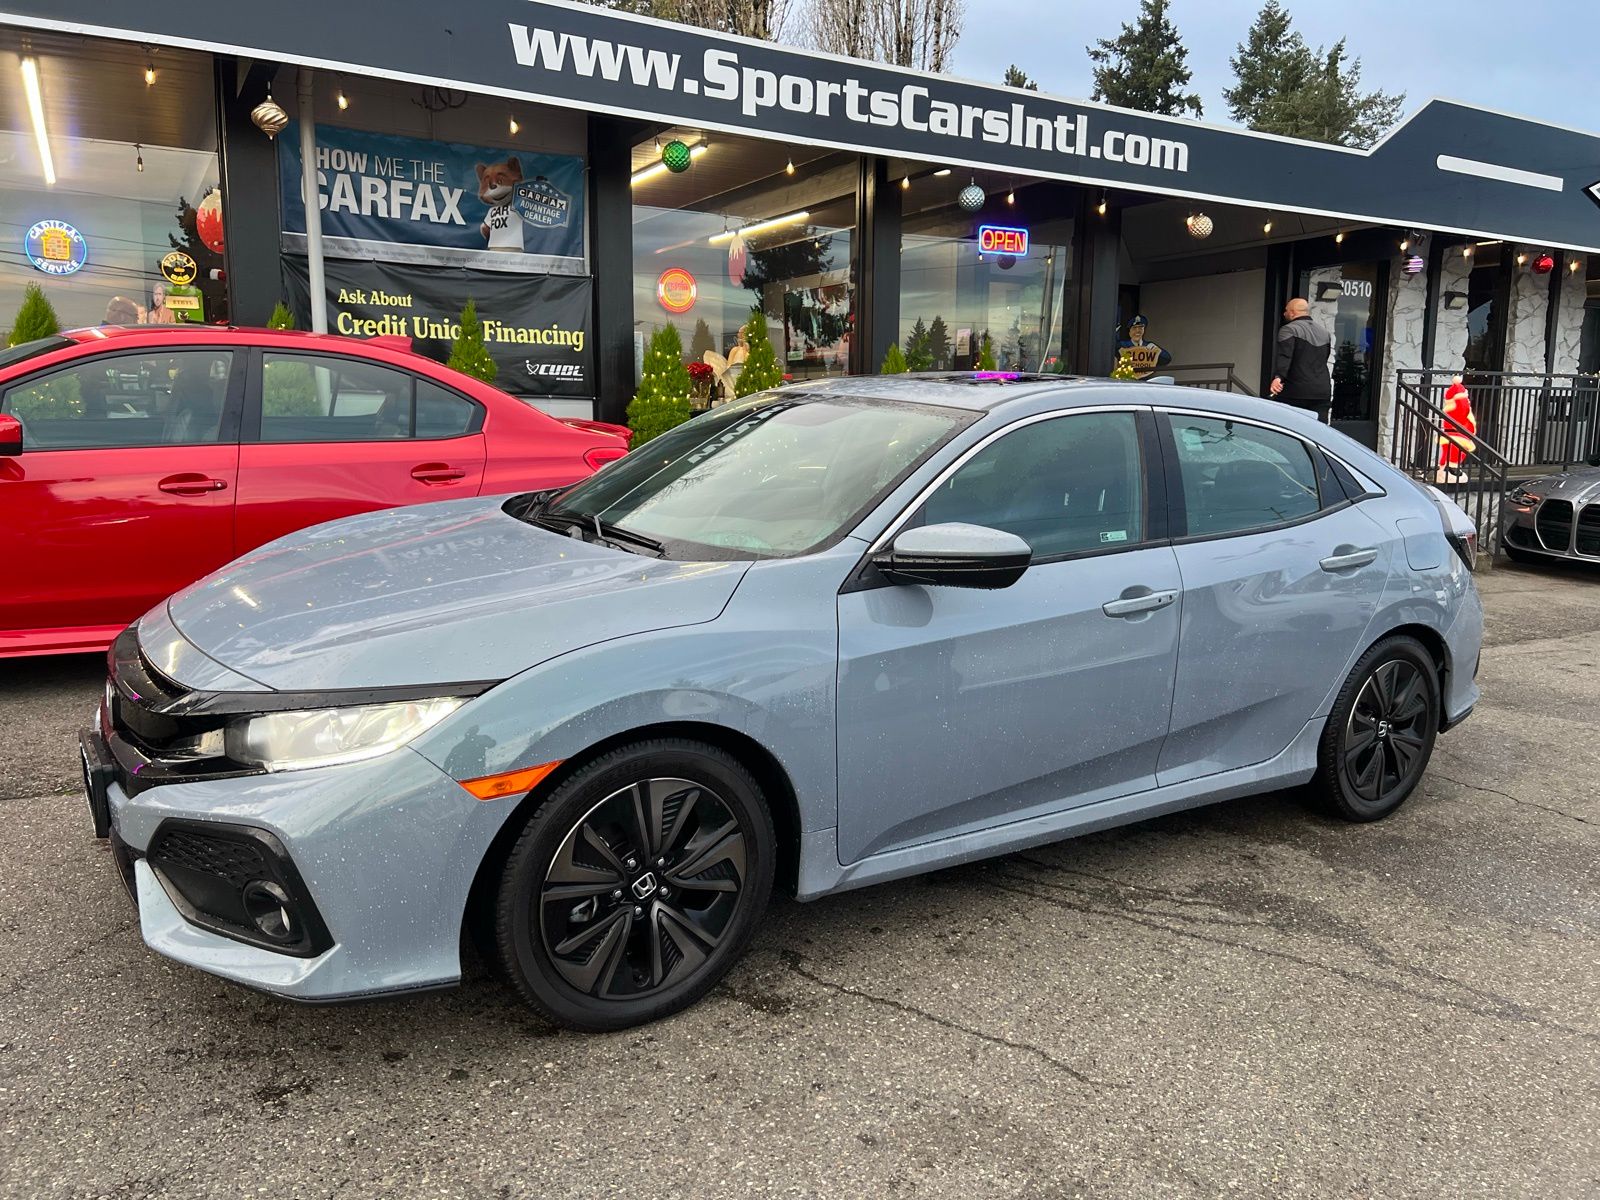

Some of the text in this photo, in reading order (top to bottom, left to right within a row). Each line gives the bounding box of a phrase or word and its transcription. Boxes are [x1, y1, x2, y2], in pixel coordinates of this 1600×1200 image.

[508, 23, 1189, 172] www.SportsCarsIntl.com
[300, 147, 445, 184] HOW ME THE
[518, 188, 567, 211] CARFAX
[520, 199, 561, 219] ADVANTAGE
[490, 205, 510, 218] CAR
[524, 211, 552, 225] DEALER
[29, 220, 81, 243] CADILLAC
[490, 216, 508, 231] FOX
[982, 229, 1026, 252] OPEN
[35, 257, 79, 273] SERVICE
[338, 288, 412, 307] Ask About
[337, 312, 585, 352] Credit Unio Financing
